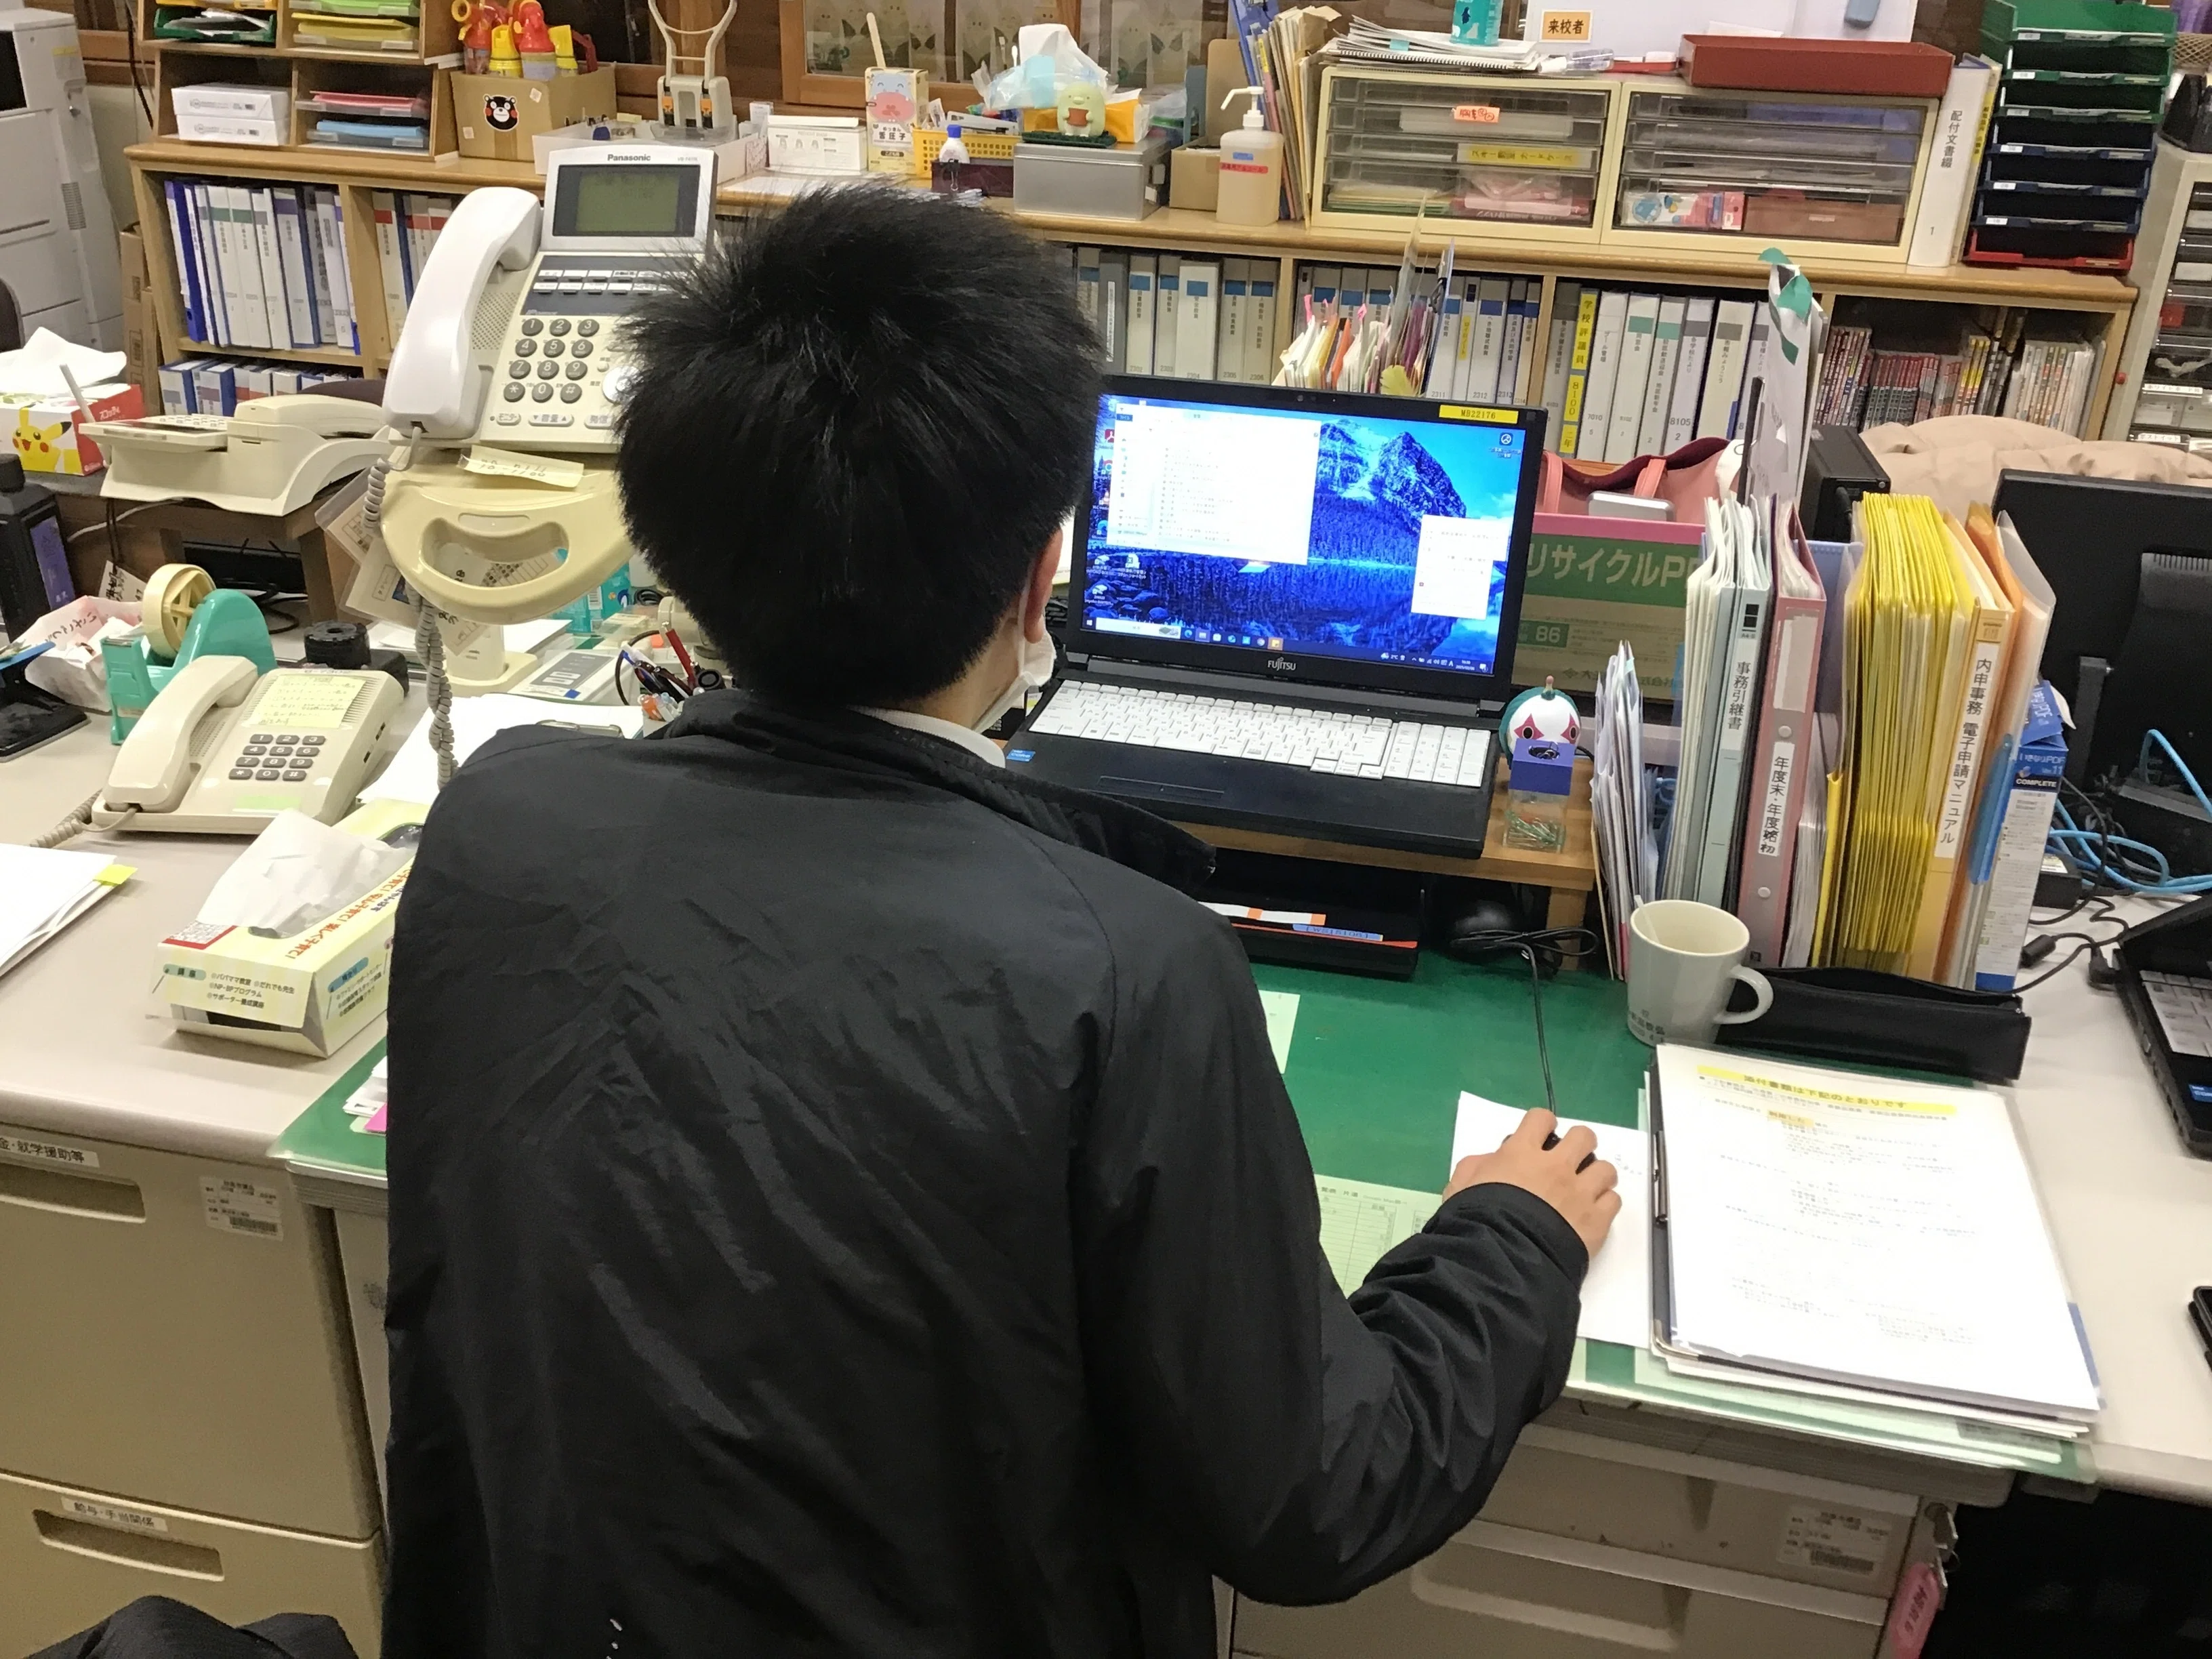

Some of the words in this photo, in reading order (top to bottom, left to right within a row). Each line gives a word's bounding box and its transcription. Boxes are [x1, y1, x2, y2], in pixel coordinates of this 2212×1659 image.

[1548, 20, 1584, 34] 来校者
[1941, 110, 1962, 168] 配付文書綴
[607, 154, 651, 162] Panasonic
[1576, 300, 1593, 365] 学校評議員
[1569, 382, 1579, 415] 8100
[1460, 409, 1496, 419] MB22176
[1670, 417, 1691, 427] 8105
[1675, 432, 1681, 441] 2
[1536, 625, 1560, 643] 86
[1267, 657, 1296, 671] FUJITSU
[1727, 661, 1750, 731] 事務引継書
[1967, 658, 1992, 716] 内申事務
[1940, 722, 1980, 844] 電子申請マニュアル
[2016, 778, 2057, 788] COMPLETE
[177, 968, 197, 979] 講座
[216, 972, 251, 986] パパママ教室
[1744, 1075, 1907, 1108] 添付書類は下記のとおりです
[0, 1138, 85, 1164] 金・就学援助等
[74, 1502, 155, 1528] 給与・手当関係
